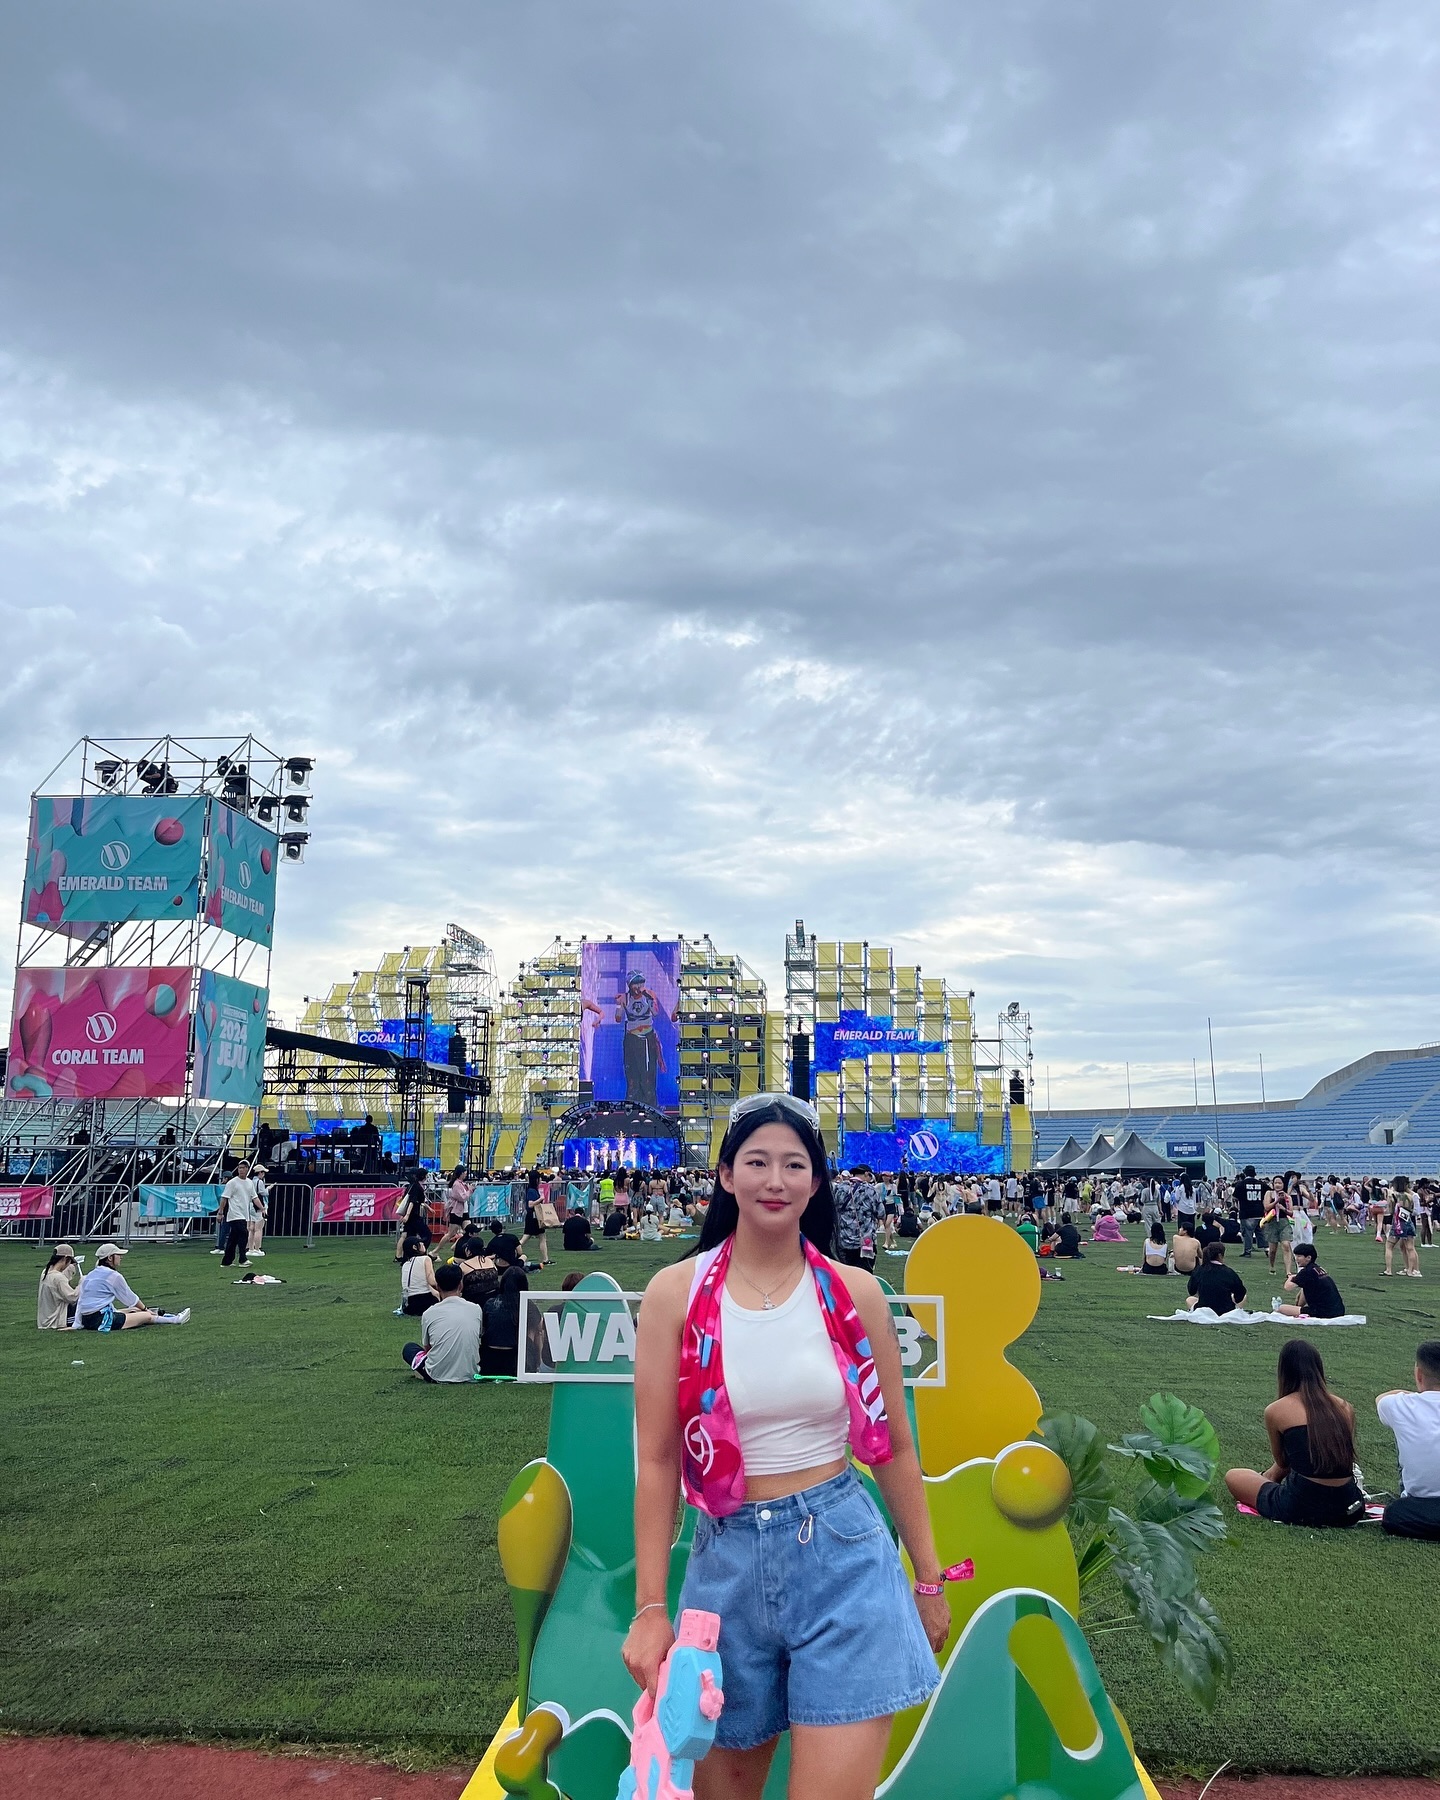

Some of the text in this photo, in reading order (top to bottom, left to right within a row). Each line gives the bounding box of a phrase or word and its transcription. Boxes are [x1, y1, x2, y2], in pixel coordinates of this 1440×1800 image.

[58, 876, 168, 891] EMERALD TEAM
[221, 885, 265, 917] EMERALD TEAM
[219, 1019, 248, 1044] 2024
[360, 1033, 397, 1043] CORAL
[833, 1030, 915, 1041] EMERALD TEAM
[52, 1049, 144, 1065] CORAL TEAM
[217, 1041, 248, 1070] JEJU
[175, 1196, 201, 1204] 2024
[349, 1198, 375, 1207] 2024
[348, 1206, 375, 1217] JEJU
